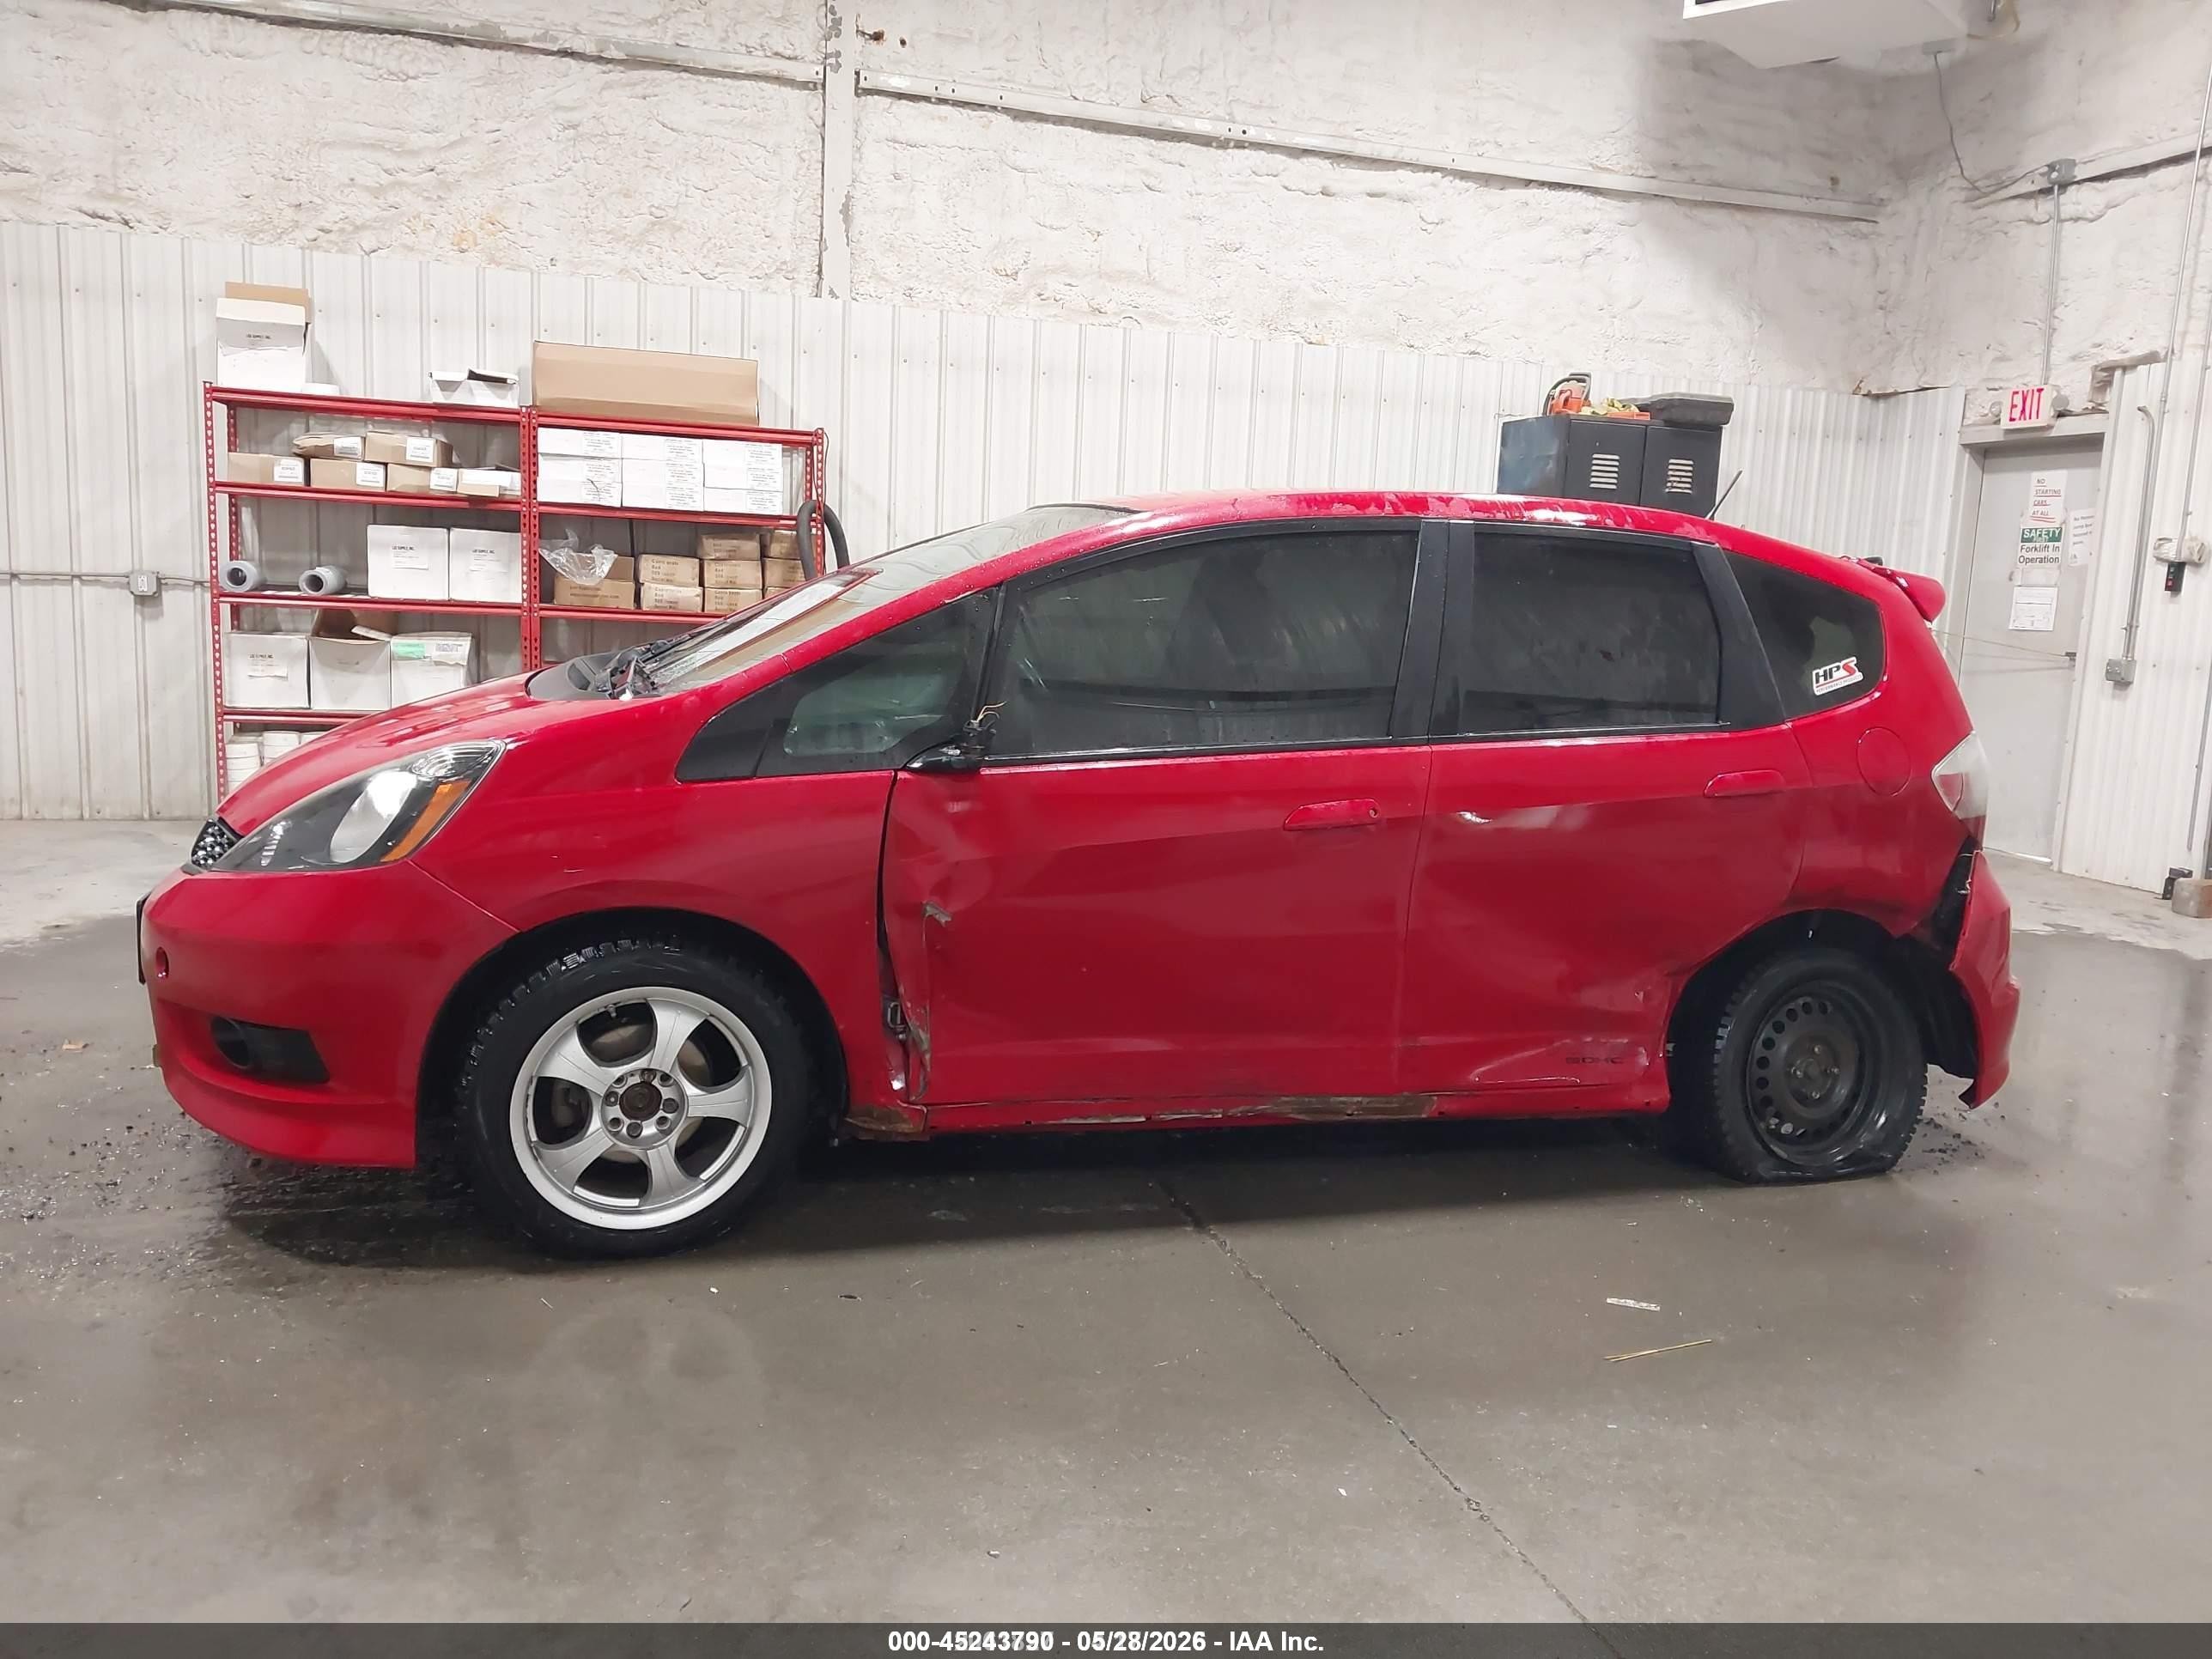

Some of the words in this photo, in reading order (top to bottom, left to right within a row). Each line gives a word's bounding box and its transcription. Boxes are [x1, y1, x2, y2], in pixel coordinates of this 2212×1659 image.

[2009, 387, 2045, 422] EXIT
[2023, 528, 2061, 538] SAFETY
[2021, 544, 2050, 553] Forklift
[2018, 555, 2060, 566] Operation
[1815, 659, 1856, 684] HPS
